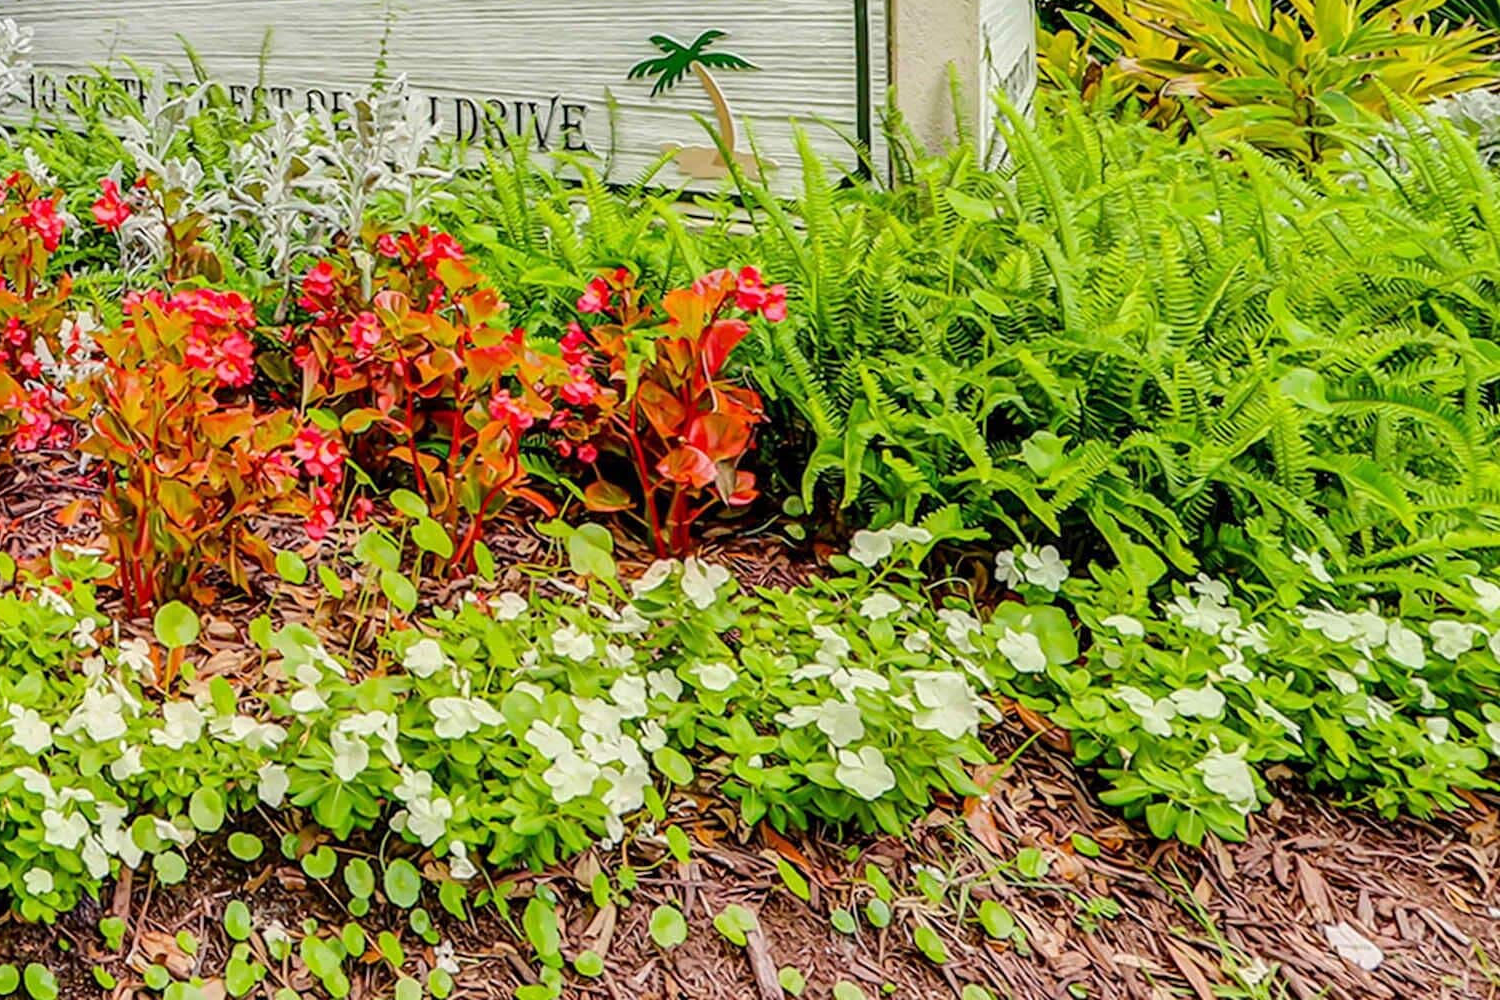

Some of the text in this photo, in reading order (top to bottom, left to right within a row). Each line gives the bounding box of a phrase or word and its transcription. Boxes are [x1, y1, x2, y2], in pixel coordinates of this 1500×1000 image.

[29, 74, 57, 112] 10
[167, 81, 293, 124] EST
[455, 94, 588, 151] DRIVE
